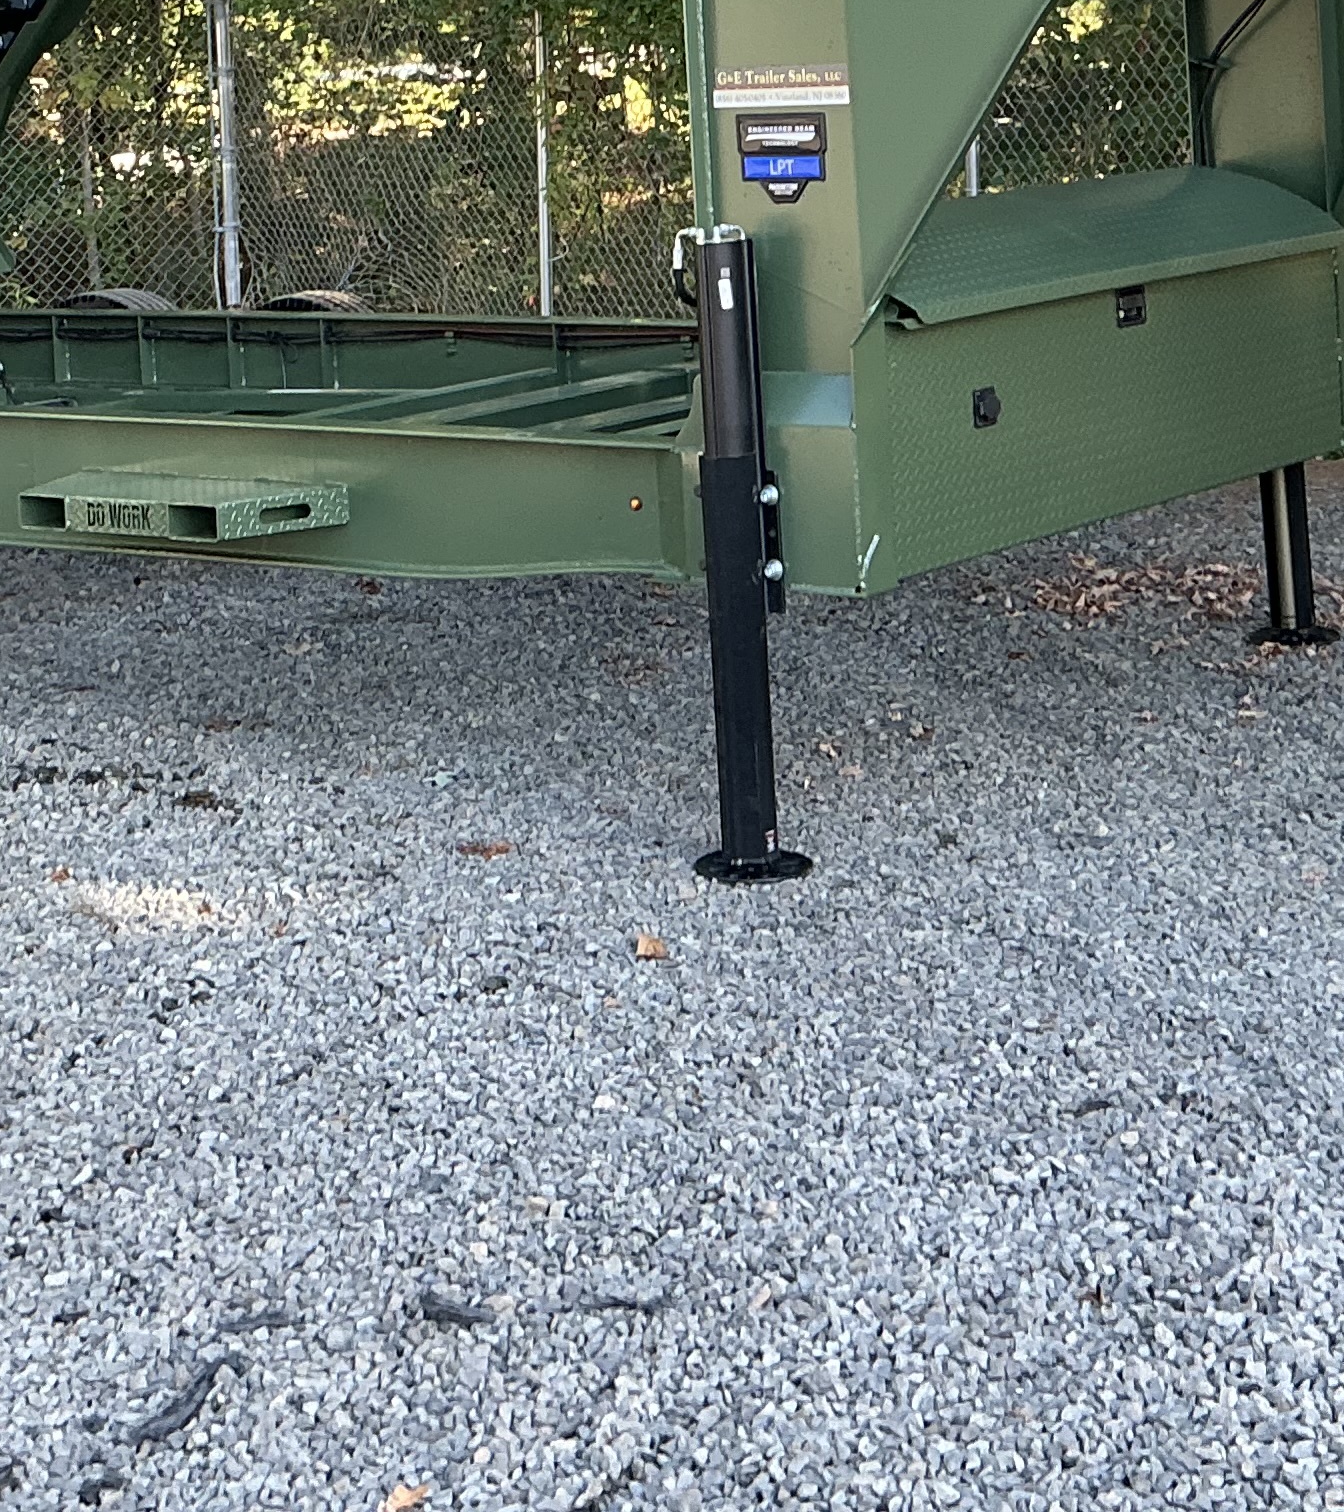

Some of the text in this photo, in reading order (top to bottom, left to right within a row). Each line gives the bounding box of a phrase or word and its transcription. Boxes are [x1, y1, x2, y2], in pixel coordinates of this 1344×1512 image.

[744, 69, 786, 85] Trailer
[788, 67, 821, 84] Sales,
[769, 158, 795, 176] LPT
[87, 502, 151, 530] DO WORK
